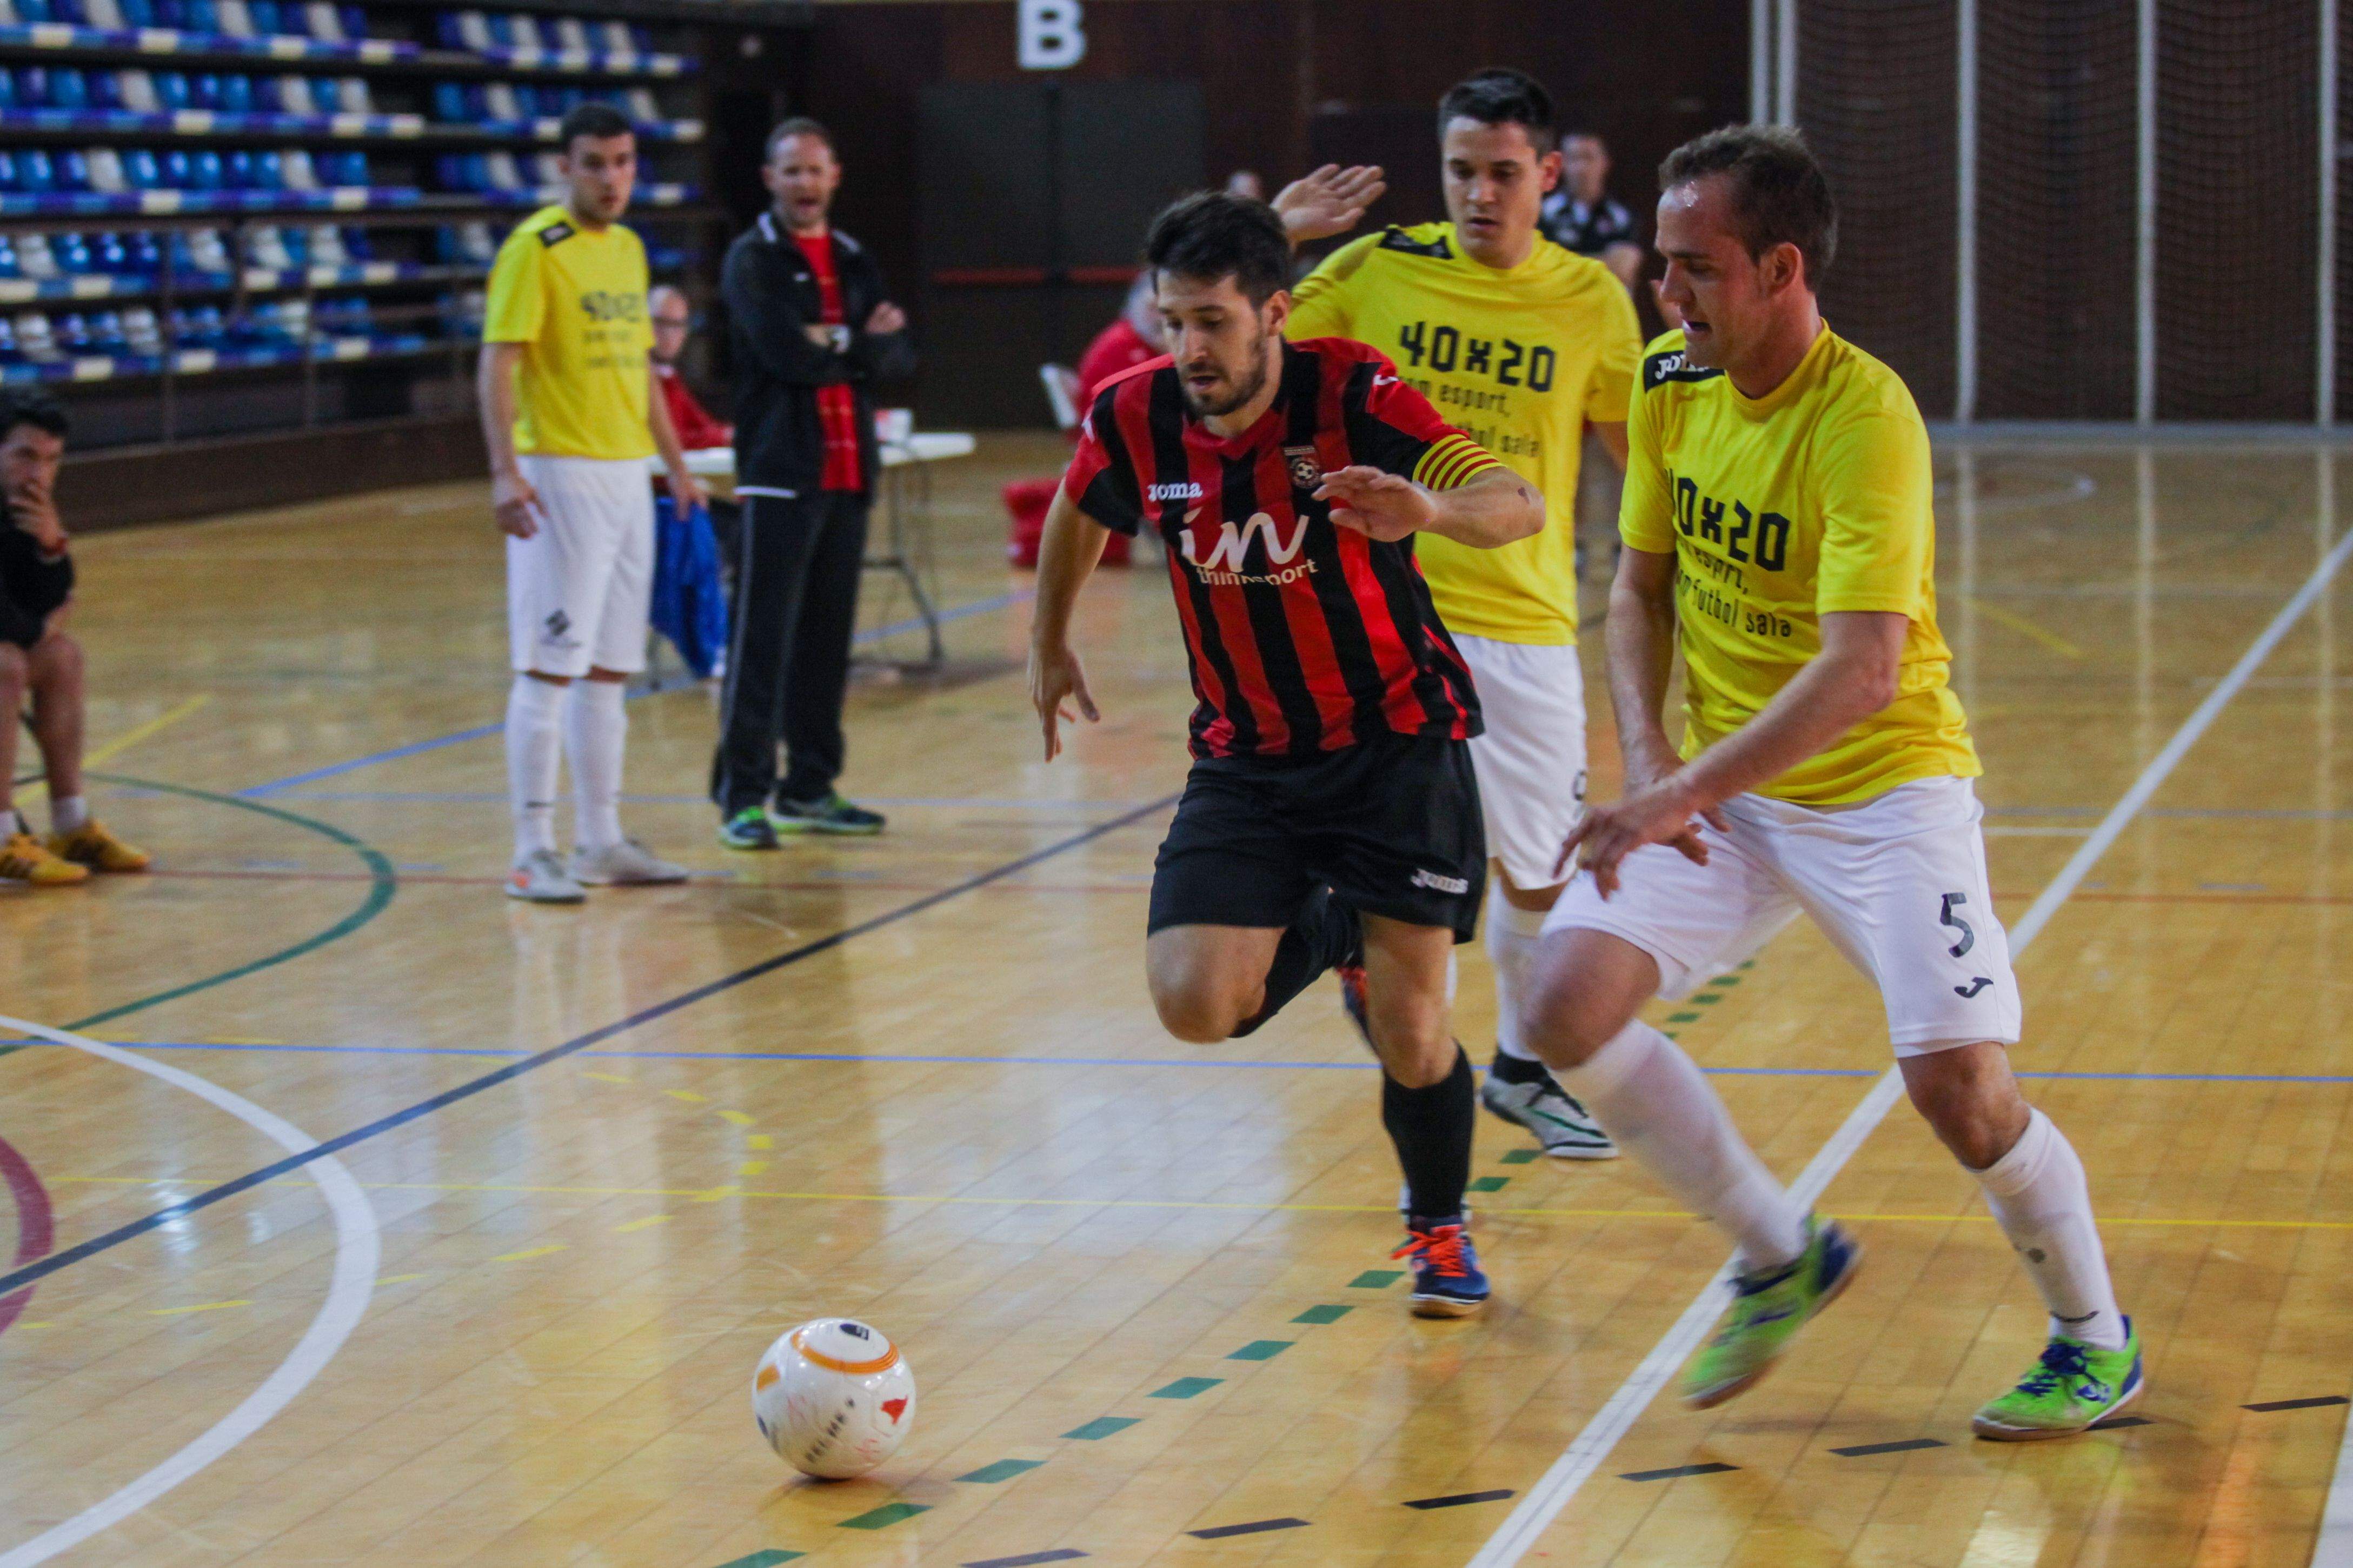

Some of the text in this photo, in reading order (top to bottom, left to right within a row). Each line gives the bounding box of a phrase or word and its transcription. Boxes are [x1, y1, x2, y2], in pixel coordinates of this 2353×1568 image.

[1017, 0, 1086, 70] B
[1400, 321, 1556, 392] 40x20
[1745, 611, 1791, 637] sala
[1940, 892, 1975, 958] 5
